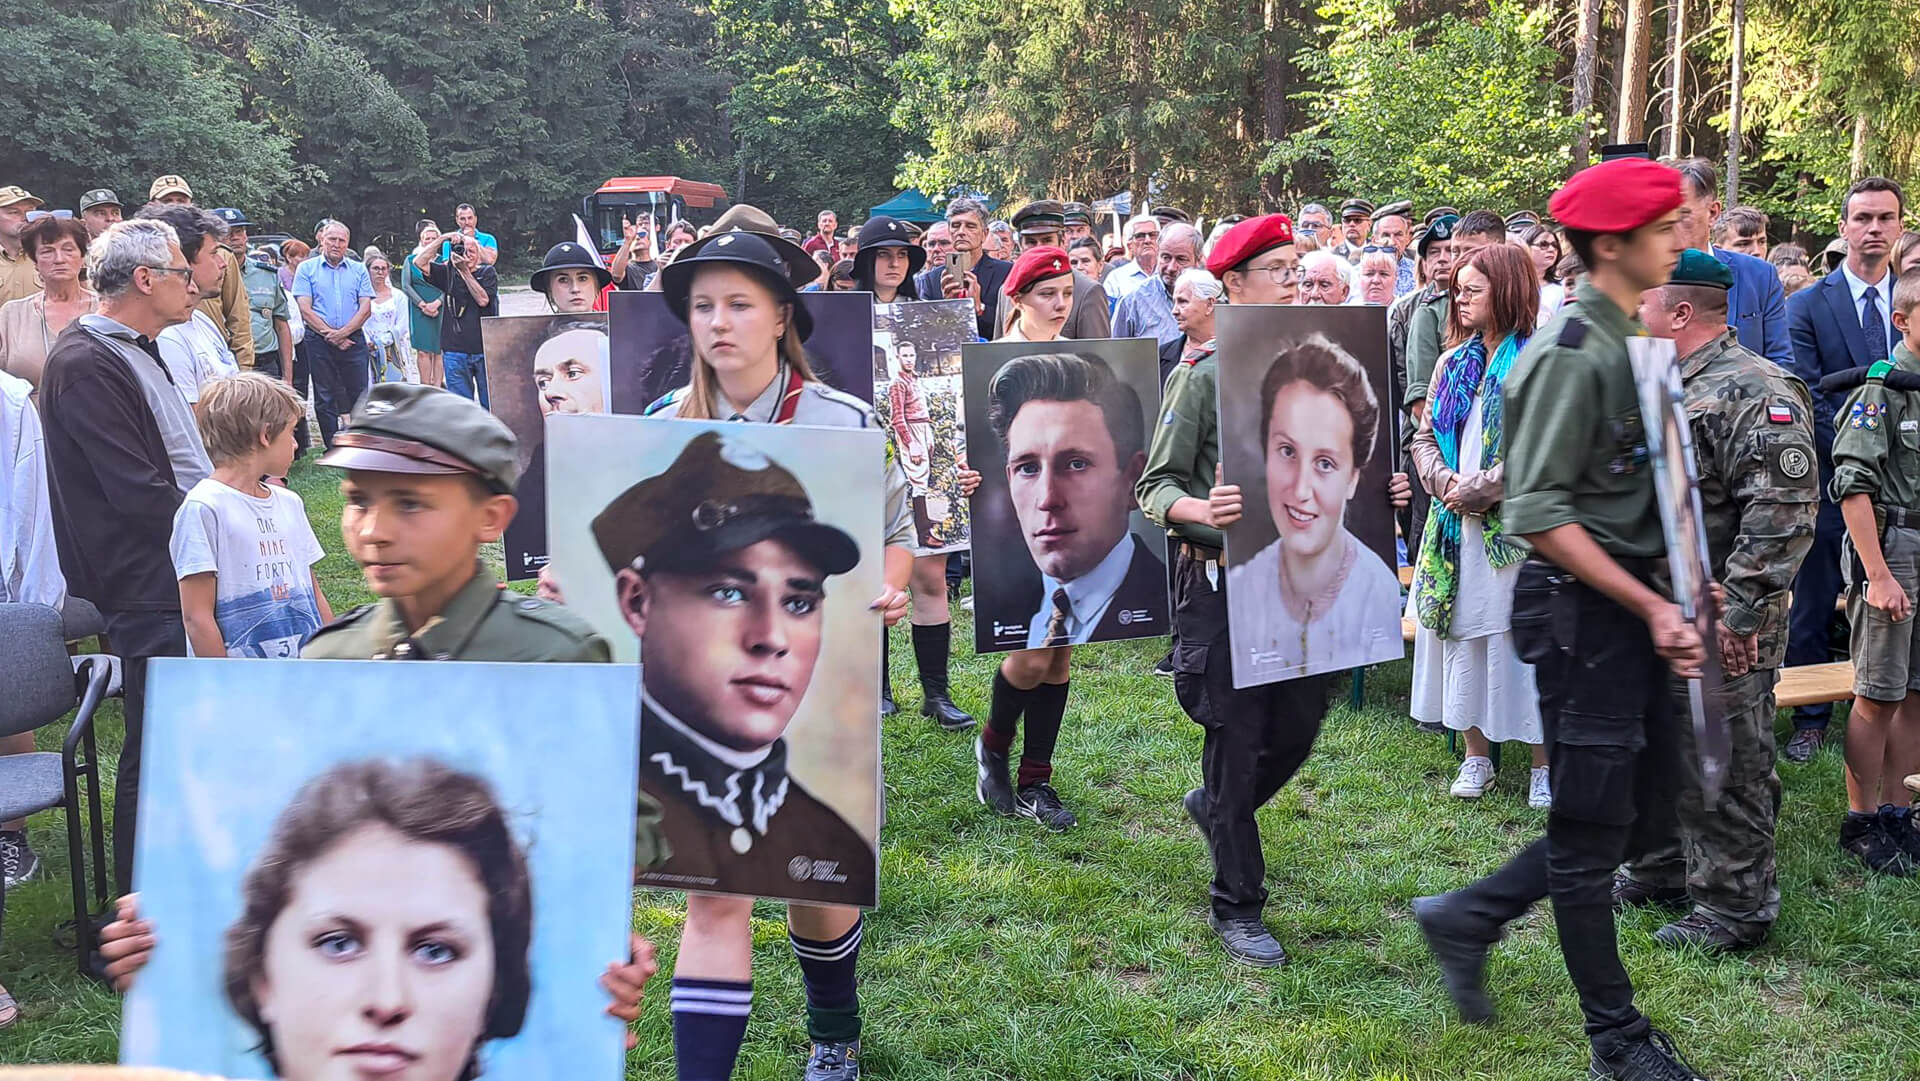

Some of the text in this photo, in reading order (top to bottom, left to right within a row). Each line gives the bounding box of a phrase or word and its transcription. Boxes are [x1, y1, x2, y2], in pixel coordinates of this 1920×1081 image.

[256, 517, 278, 534] ONE
[258, 539, 287, 557] NINE
[256, 560, 294, 581] FORTY
